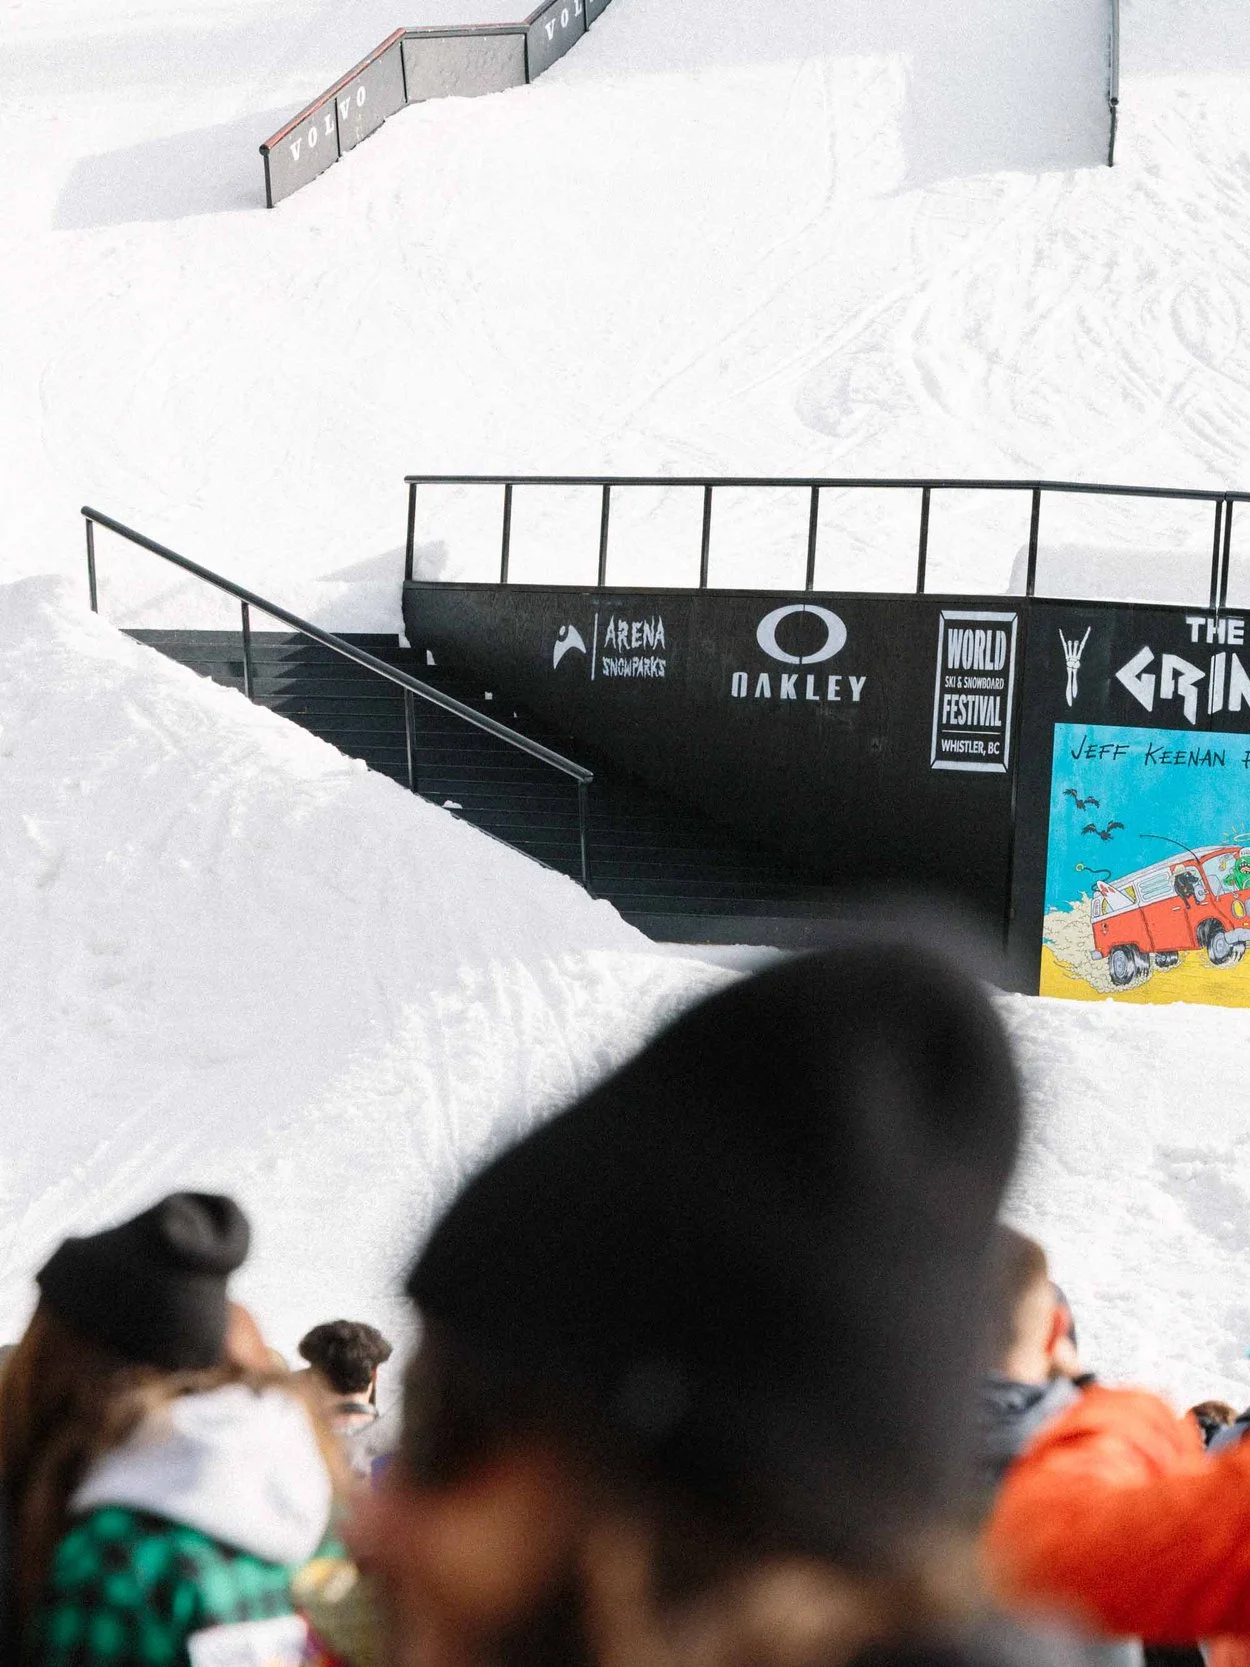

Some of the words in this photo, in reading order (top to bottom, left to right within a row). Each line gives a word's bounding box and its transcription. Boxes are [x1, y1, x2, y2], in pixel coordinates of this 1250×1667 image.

[290, 86, 366, 161] VOLVO
[604, 615, 666, 654] ARENA
[1185, 616, 1245, 646] THE
[947, 628, 1007, 671] WORLD
[602, 655, 667, 679] SNOWPARKS
[944, 675, 956, 688] SKI
[957, 676, 962, 689] &
[963, 676, 1005, 690] SNOWBOARD
[731, 671, 867, 702] OAKLEY
[942, 693, 1002, 727] FESTIVAL
[941, 738, 986, 756] WHISTLER,
[988, 742, 1000, 755] BC
[1071, 735, 1130, 761] JEFF
[1144, 742, 1226, 768] KEENAN
